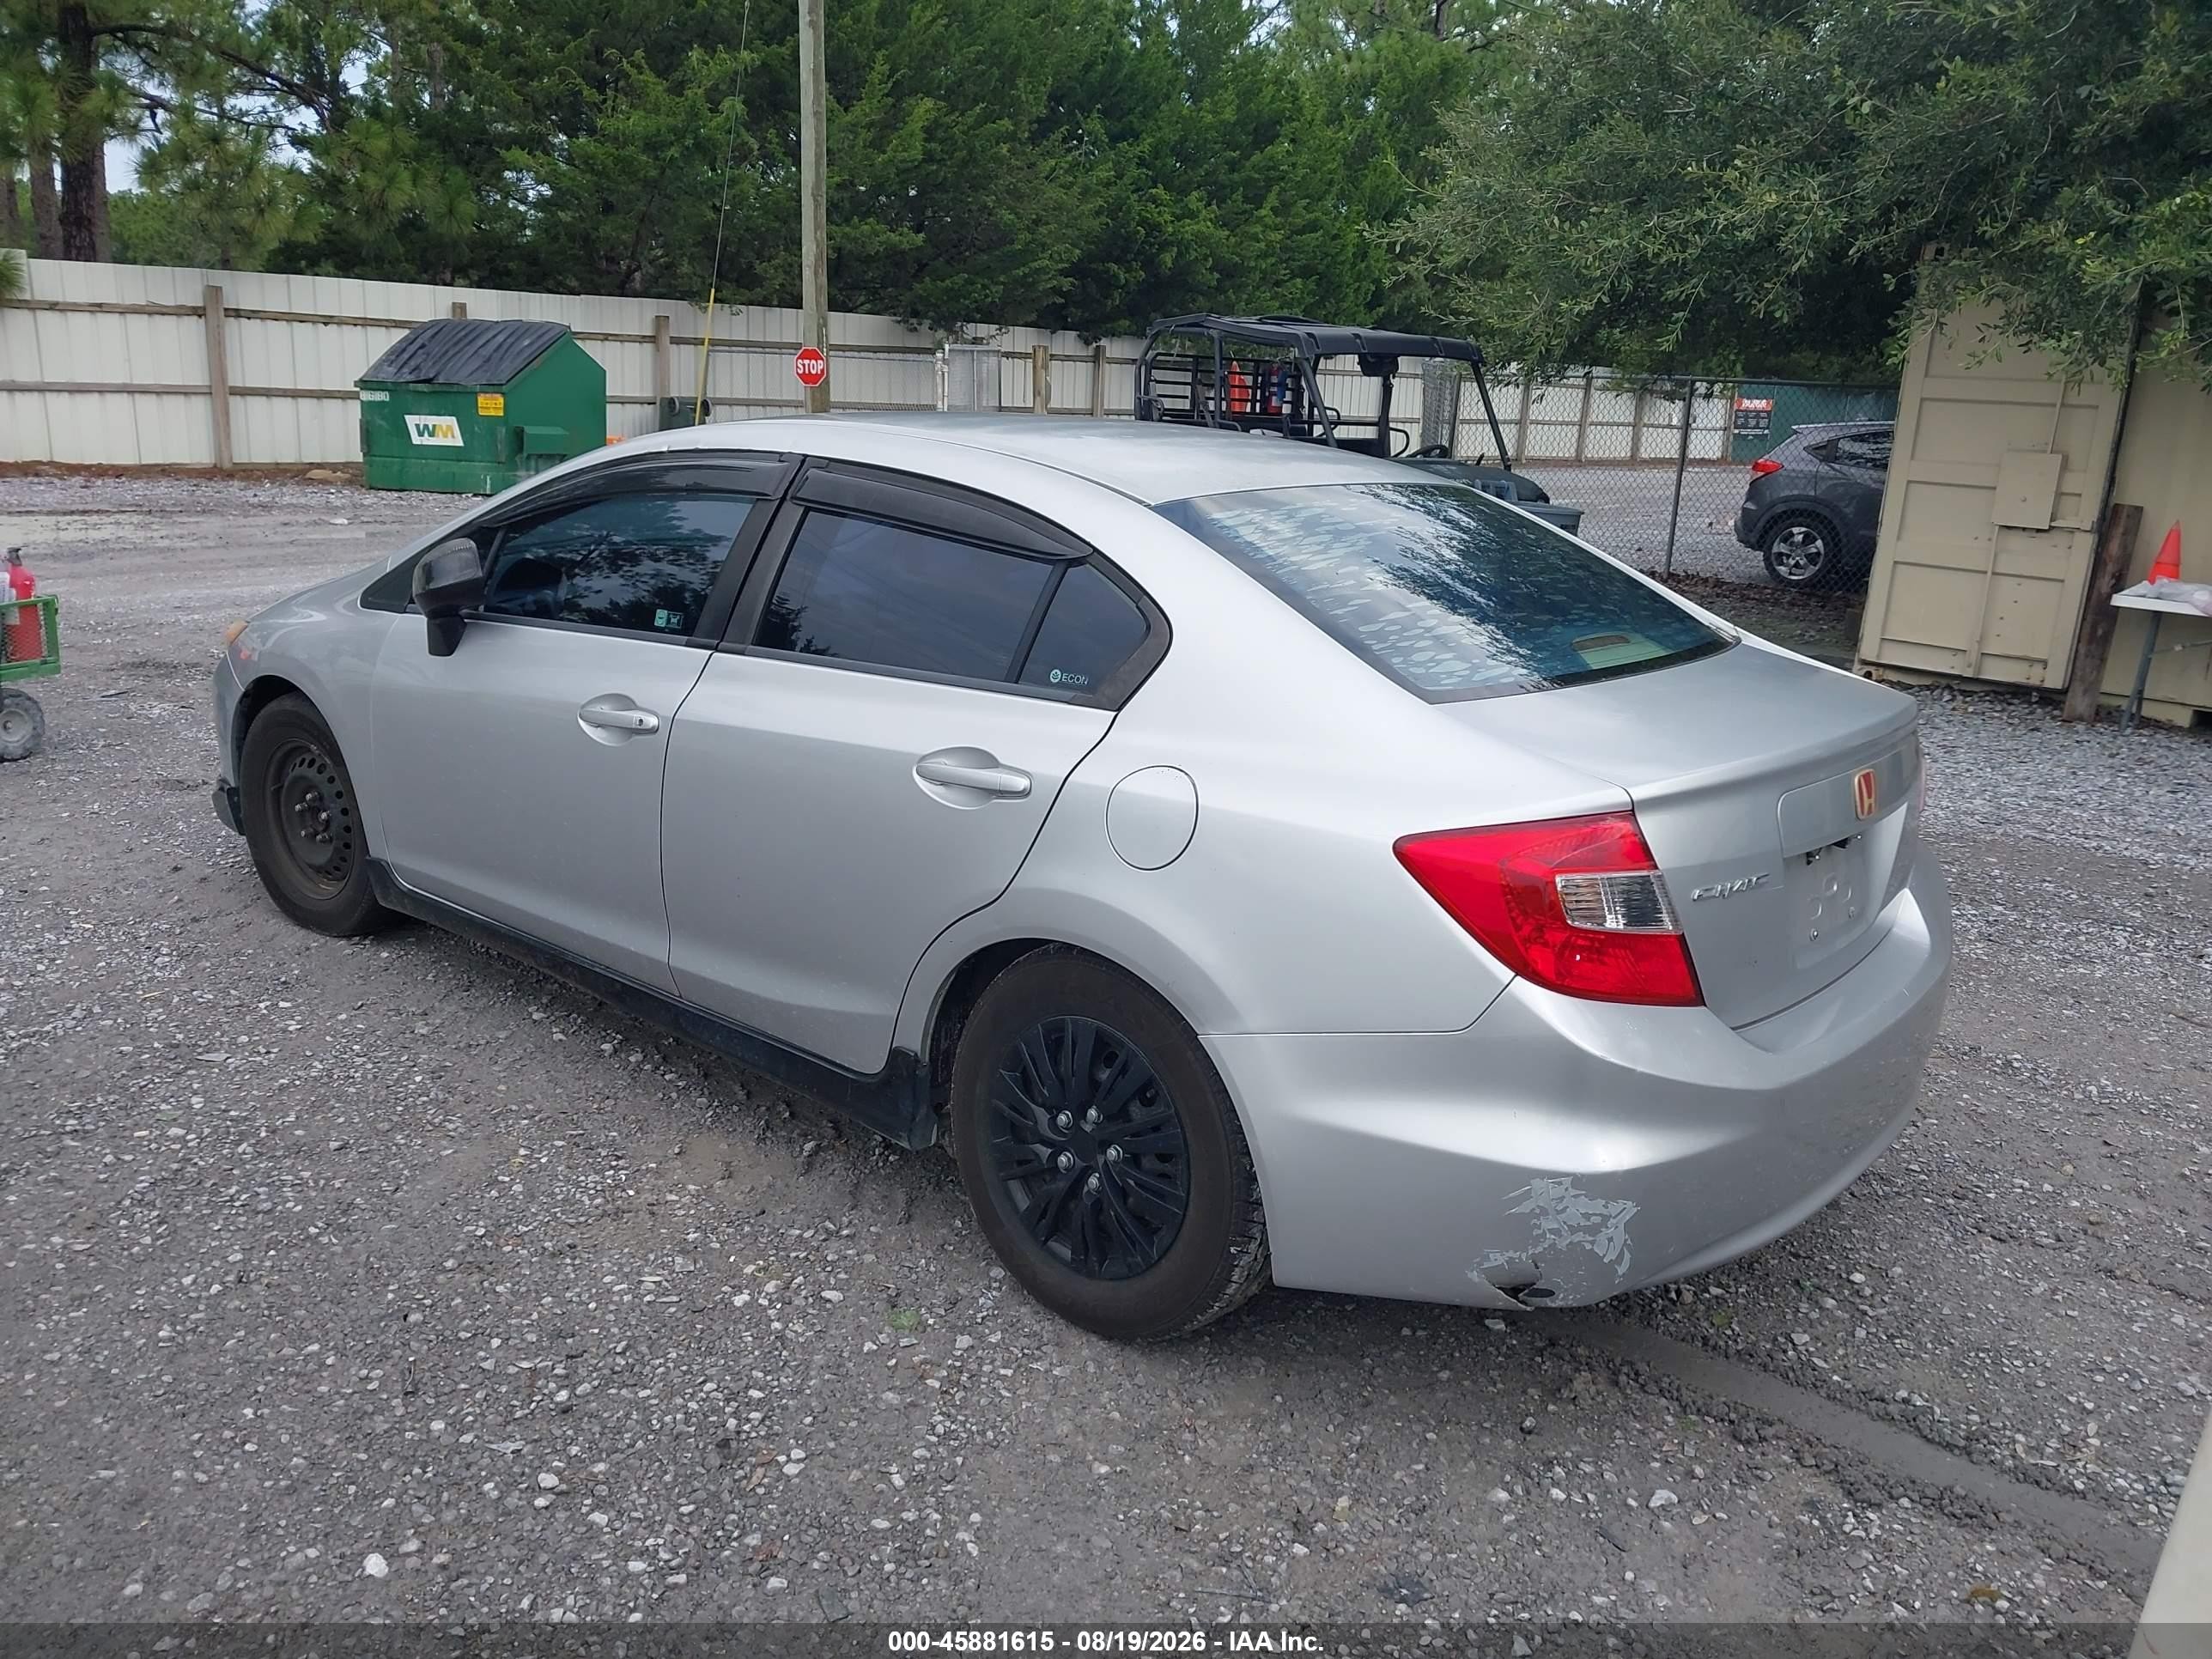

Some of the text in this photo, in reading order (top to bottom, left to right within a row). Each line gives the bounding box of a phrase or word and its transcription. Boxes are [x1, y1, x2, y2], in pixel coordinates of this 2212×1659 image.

[797, 359, 823, 374] STOP
[415, 423, 455, 439] WM
[1061, 673, 1088, 684] ECON
